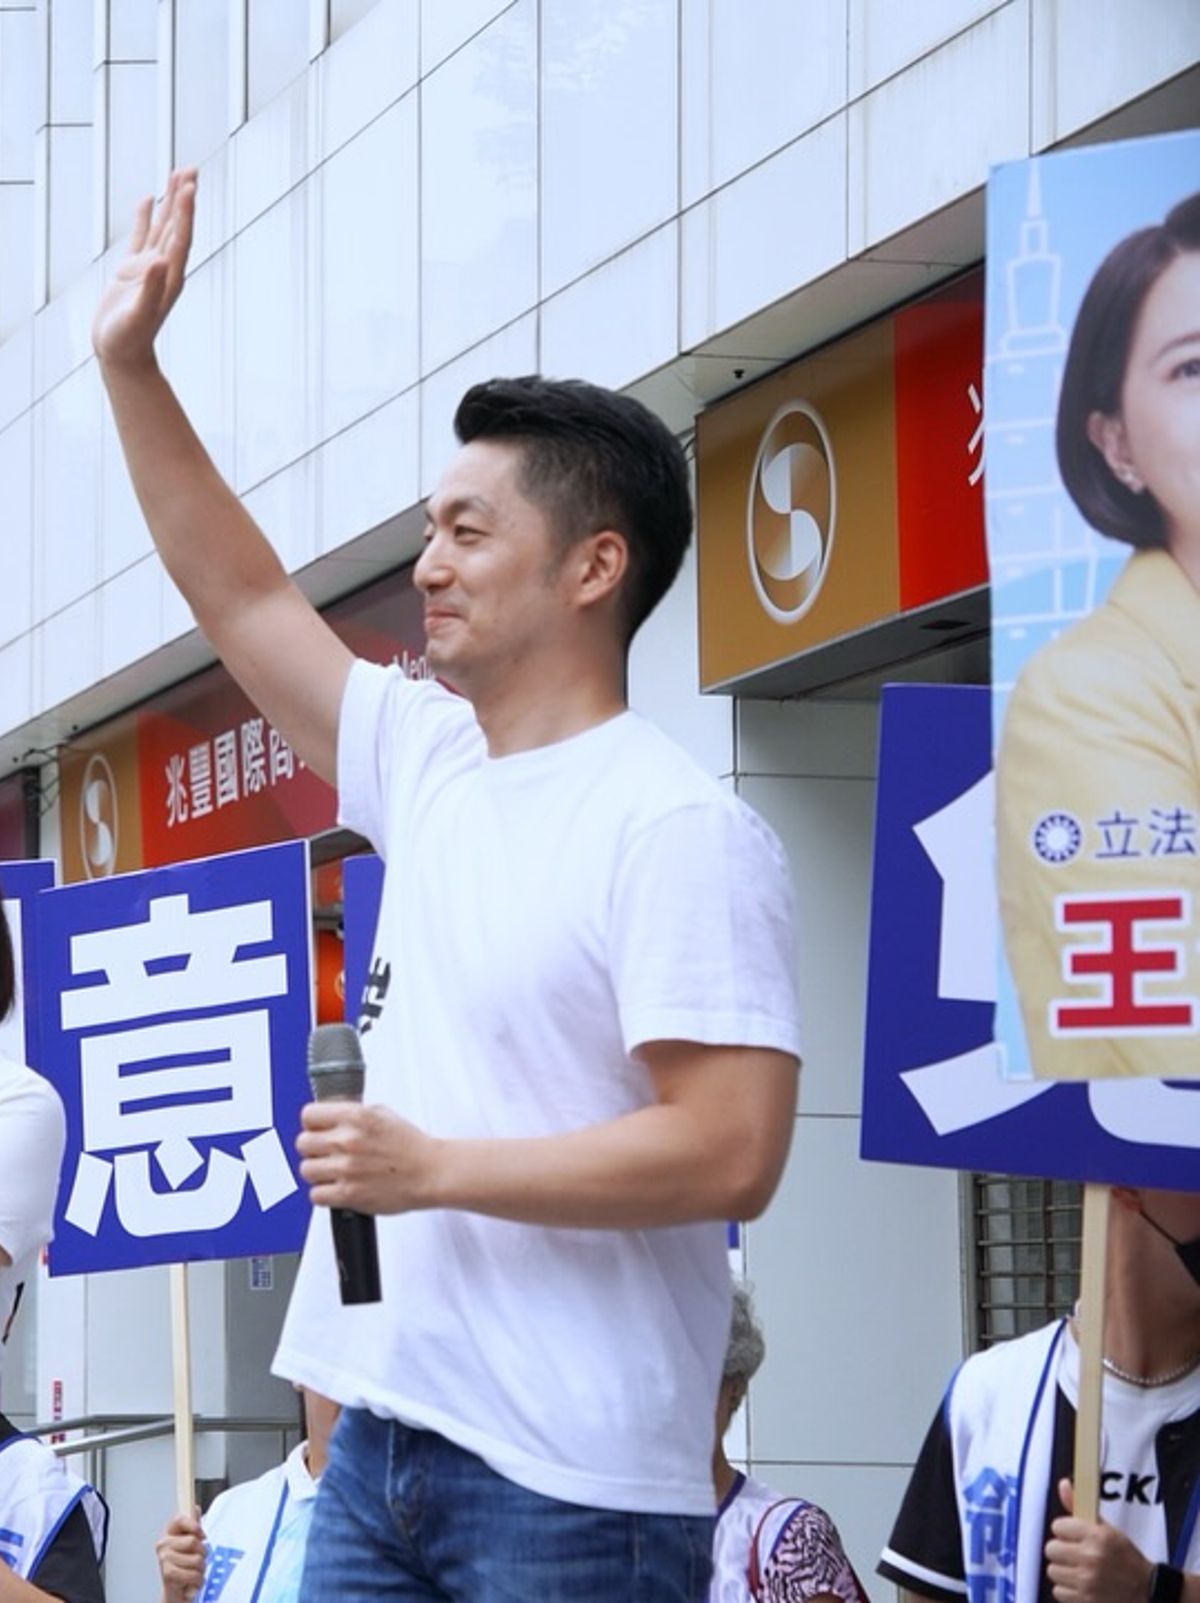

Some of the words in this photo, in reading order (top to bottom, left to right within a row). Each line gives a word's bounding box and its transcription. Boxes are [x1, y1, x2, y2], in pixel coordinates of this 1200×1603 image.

[165, 717, 306, 828] 兆豐國際商
[1095, 808, 1198, 859] 立法
[1055, 895, 1194, 1031] 王
[60, 893, 299, 1238] 意
[1101, 1472, 1163, 1506] CK
